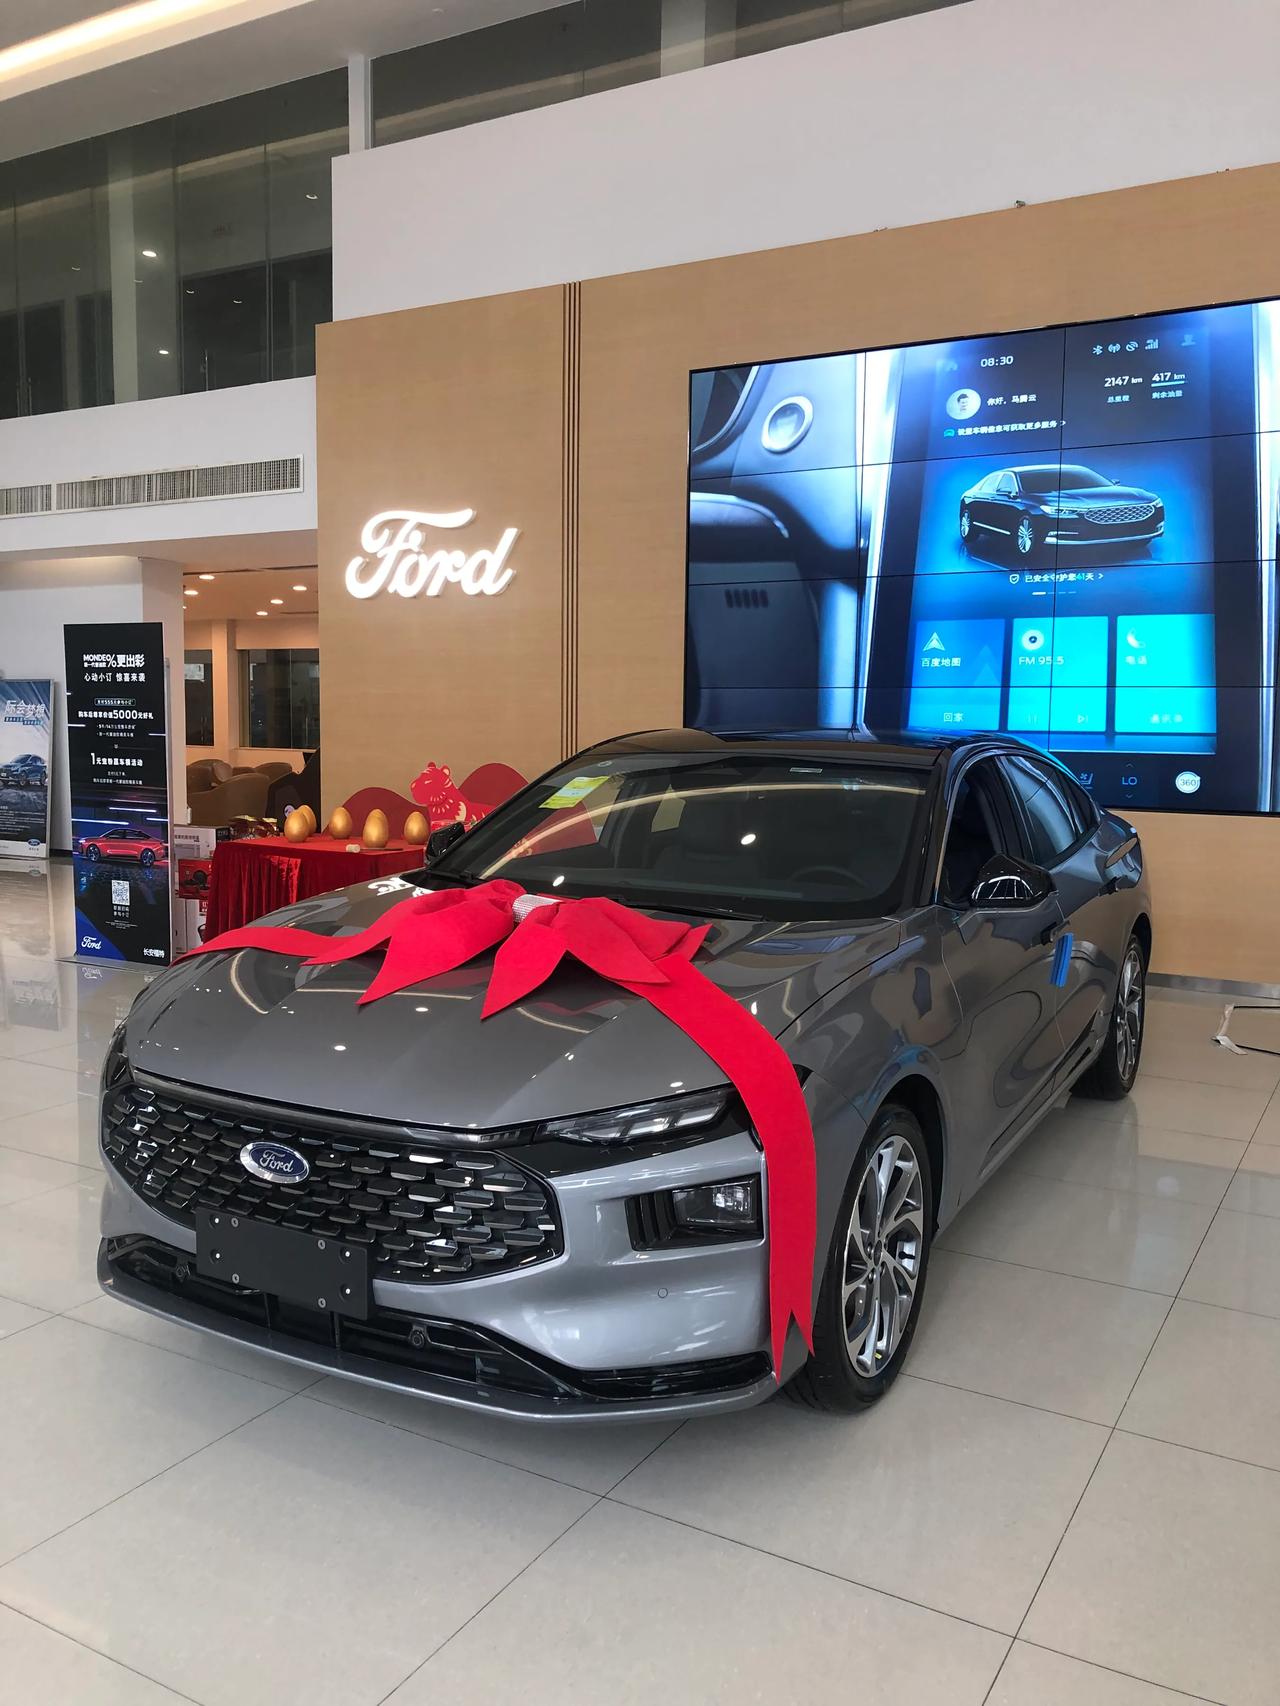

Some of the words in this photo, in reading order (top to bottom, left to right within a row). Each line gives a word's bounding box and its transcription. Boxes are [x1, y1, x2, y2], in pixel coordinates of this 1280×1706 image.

[980, 355, 1014, 368] 08:30
[1104, 376, 1130, 388] 2147
[1151, 372, 1172, 382] 417
[345, 508, 518, 600] Ford
[921, 657, 961, 668] 百度地图
[1018, 656, 1036, 665] FM
[84, 673, 112, 682] 心动小订
[115, 673, 146, 682] 惊喜来袭
[943, 712, 964, 722] 回家
[1121, 776, 1138, 786] LO
[1179, 777, 1197, 787] 360
[81, 935, 102, 950] Ford
[259, 1149, 295, 1173] Ford
